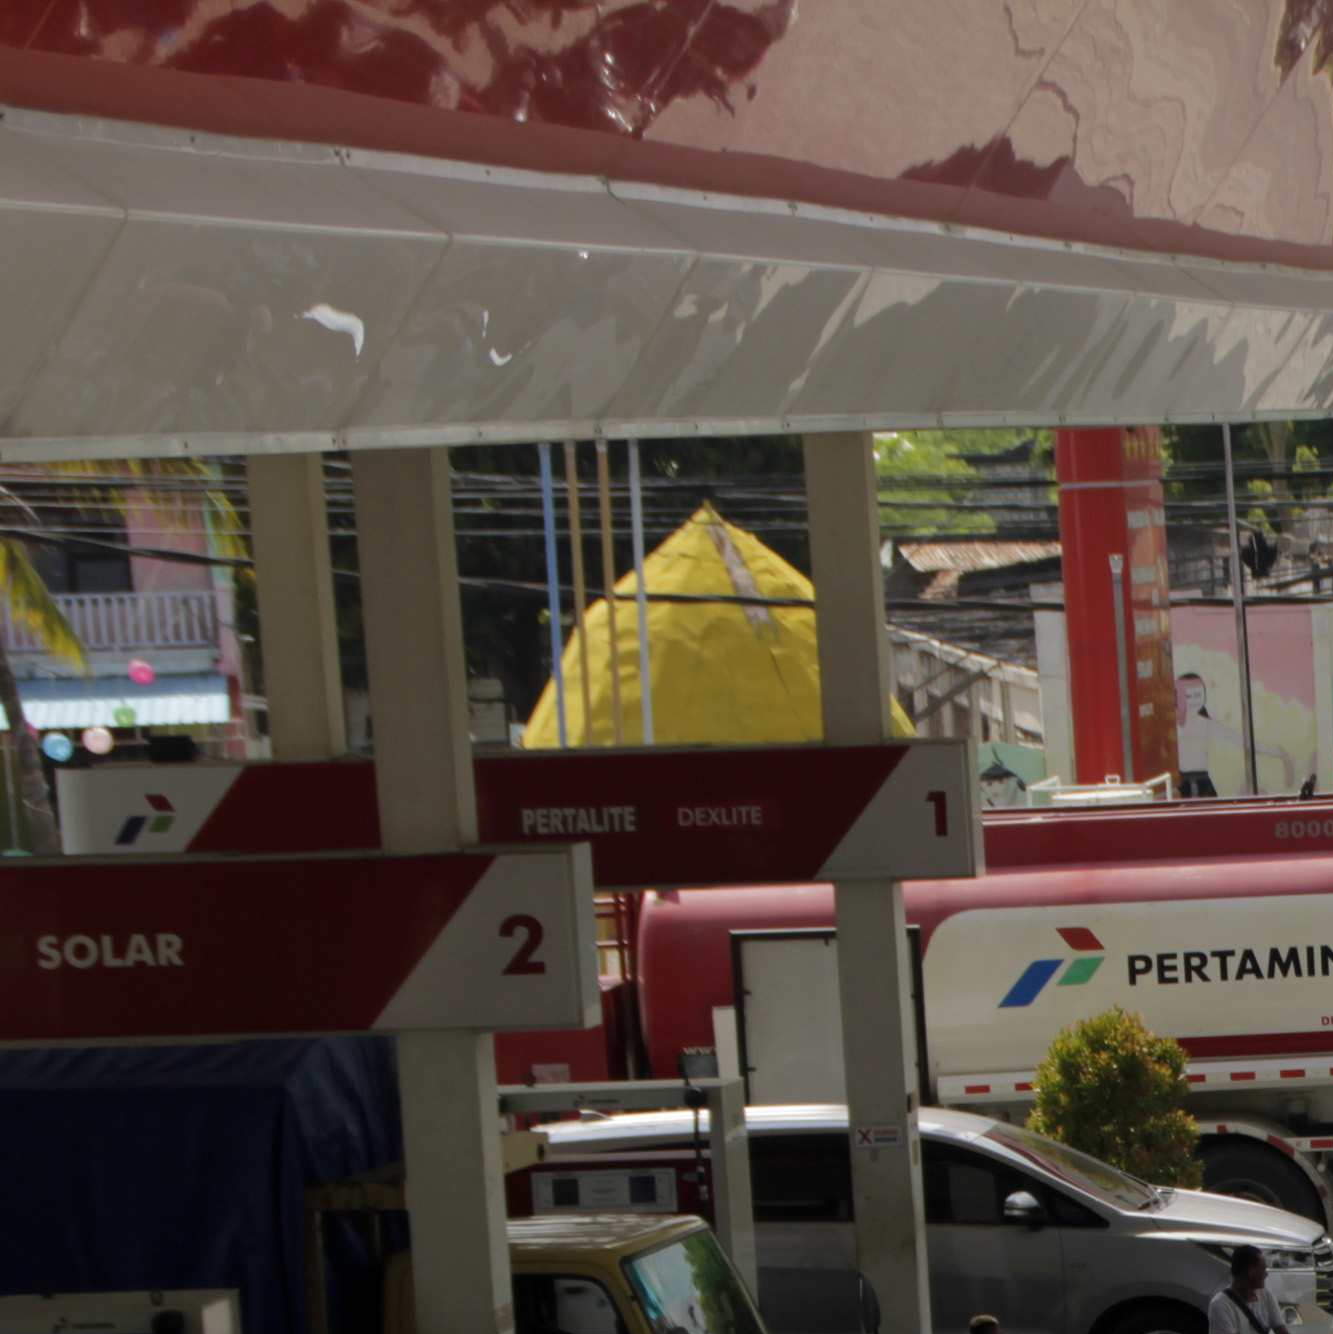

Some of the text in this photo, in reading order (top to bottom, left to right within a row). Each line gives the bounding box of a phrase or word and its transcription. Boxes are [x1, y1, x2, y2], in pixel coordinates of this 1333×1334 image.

[521, 805, 763, 835] PERTALITE DEXLITE
[926, 791, 948, 837] 1
[36, 933, 185, 970] SOLAR
[497, 913, 547, 976] 2
